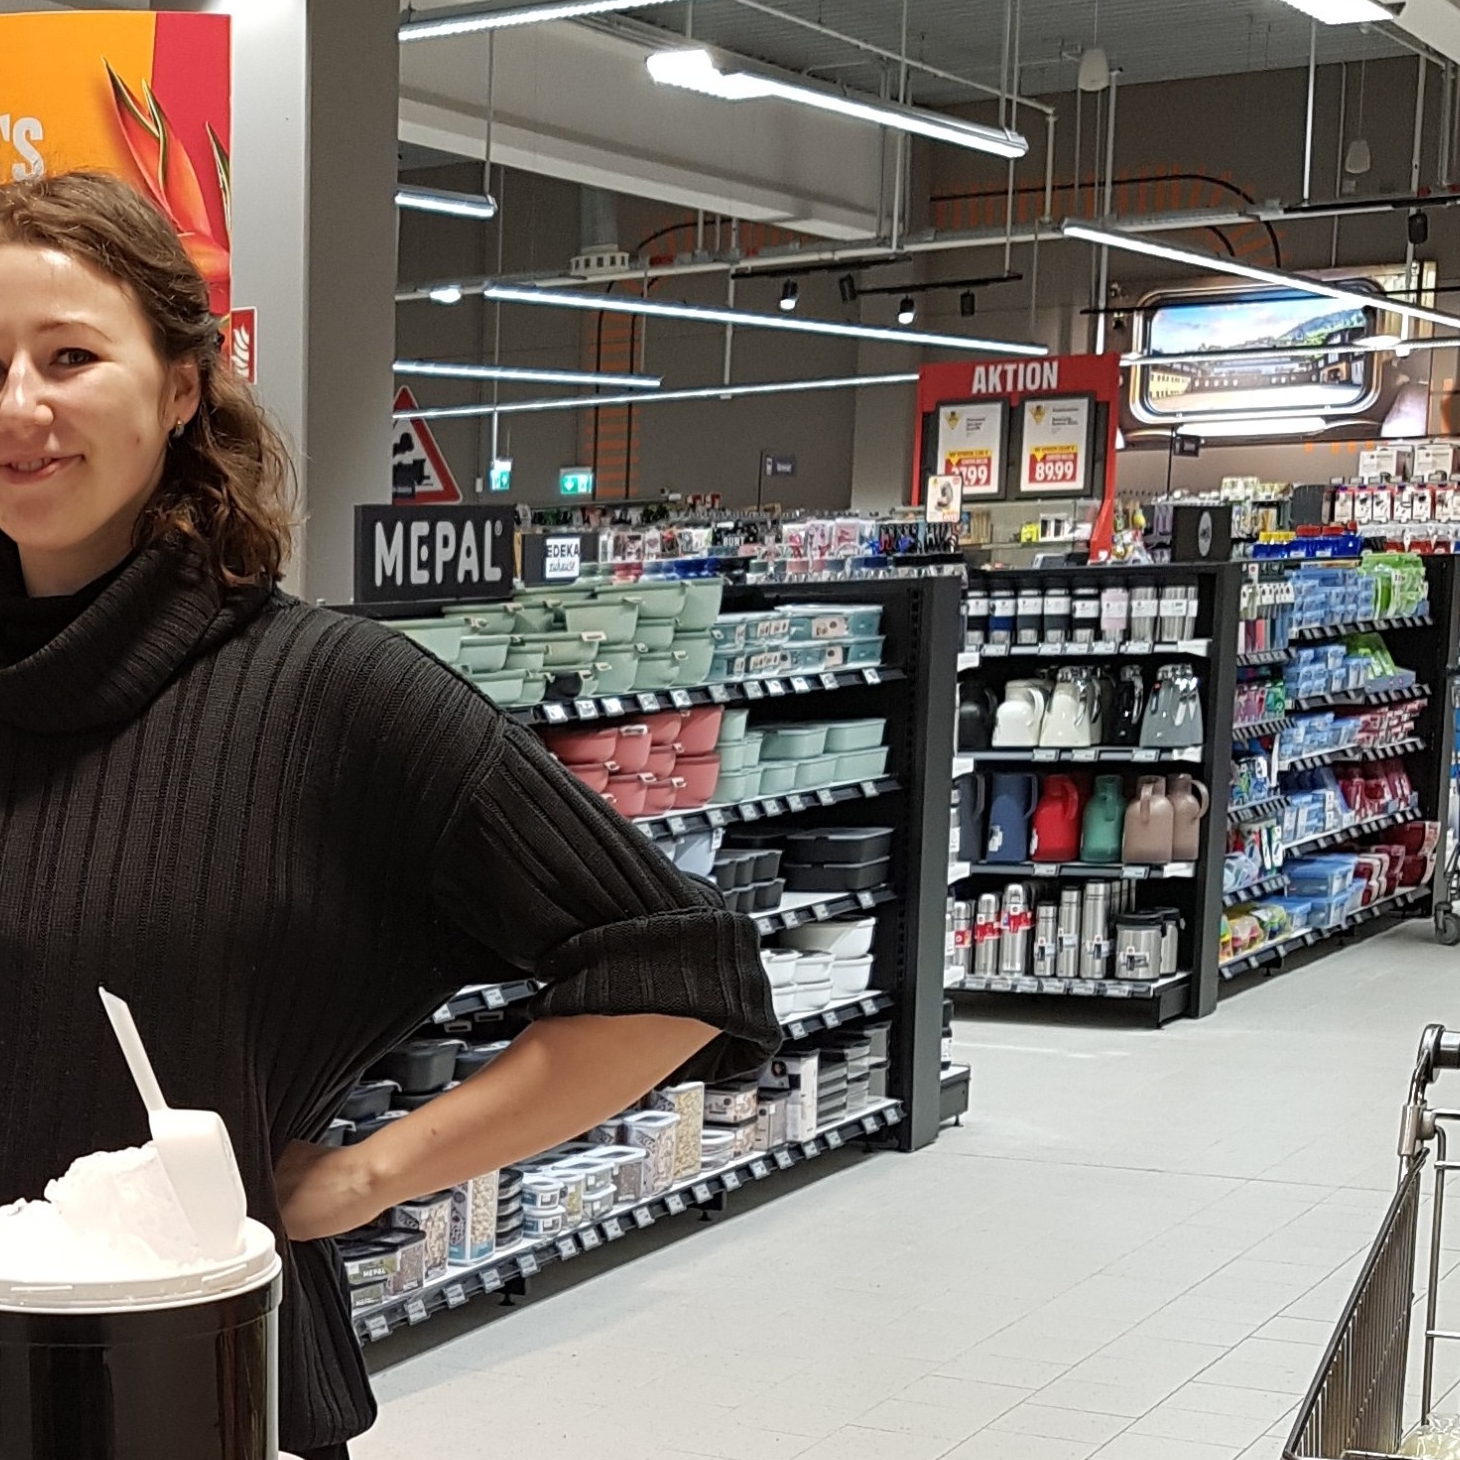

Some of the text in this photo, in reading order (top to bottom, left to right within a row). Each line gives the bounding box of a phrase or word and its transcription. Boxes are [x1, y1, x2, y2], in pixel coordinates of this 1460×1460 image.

[971, 361, 1058, 394] AKTION
[1035, 462, 1074, 480] 89.99
[546, 544, 580, 556] EDEKA
